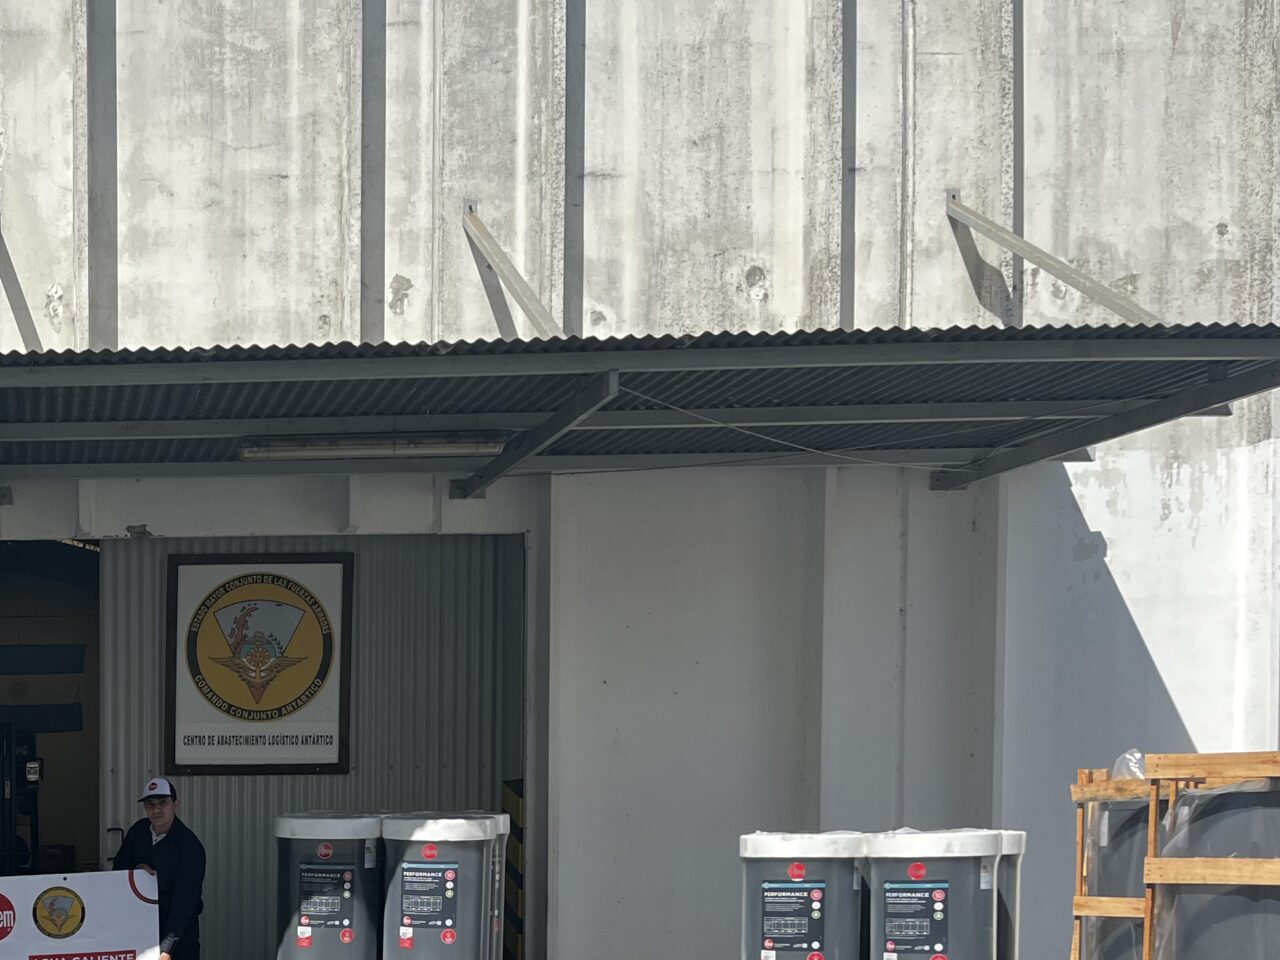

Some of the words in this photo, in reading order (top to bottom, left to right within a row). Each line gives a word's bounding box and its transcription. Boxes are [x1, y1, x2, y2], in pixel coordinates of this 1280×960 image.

[191, 605, 209, 631] ESTADO
[204, 586, 227, 607] MAYOR
[225, 575, 262, 592] CONJUNTO
[263, 575, 273, 584] DE
[274, 577, 289, 588] LAS
[287, 582, 315, 605] FUERZAS
[194, 674, 228, 711] COMANDO
[229, 706, 279, 720] CONJUNTO
[183, 735, 206, 746] CENTRO
[207, 735, 216, 746] DE
[217, 734, 267, 746] ABASTECIMIENTO
